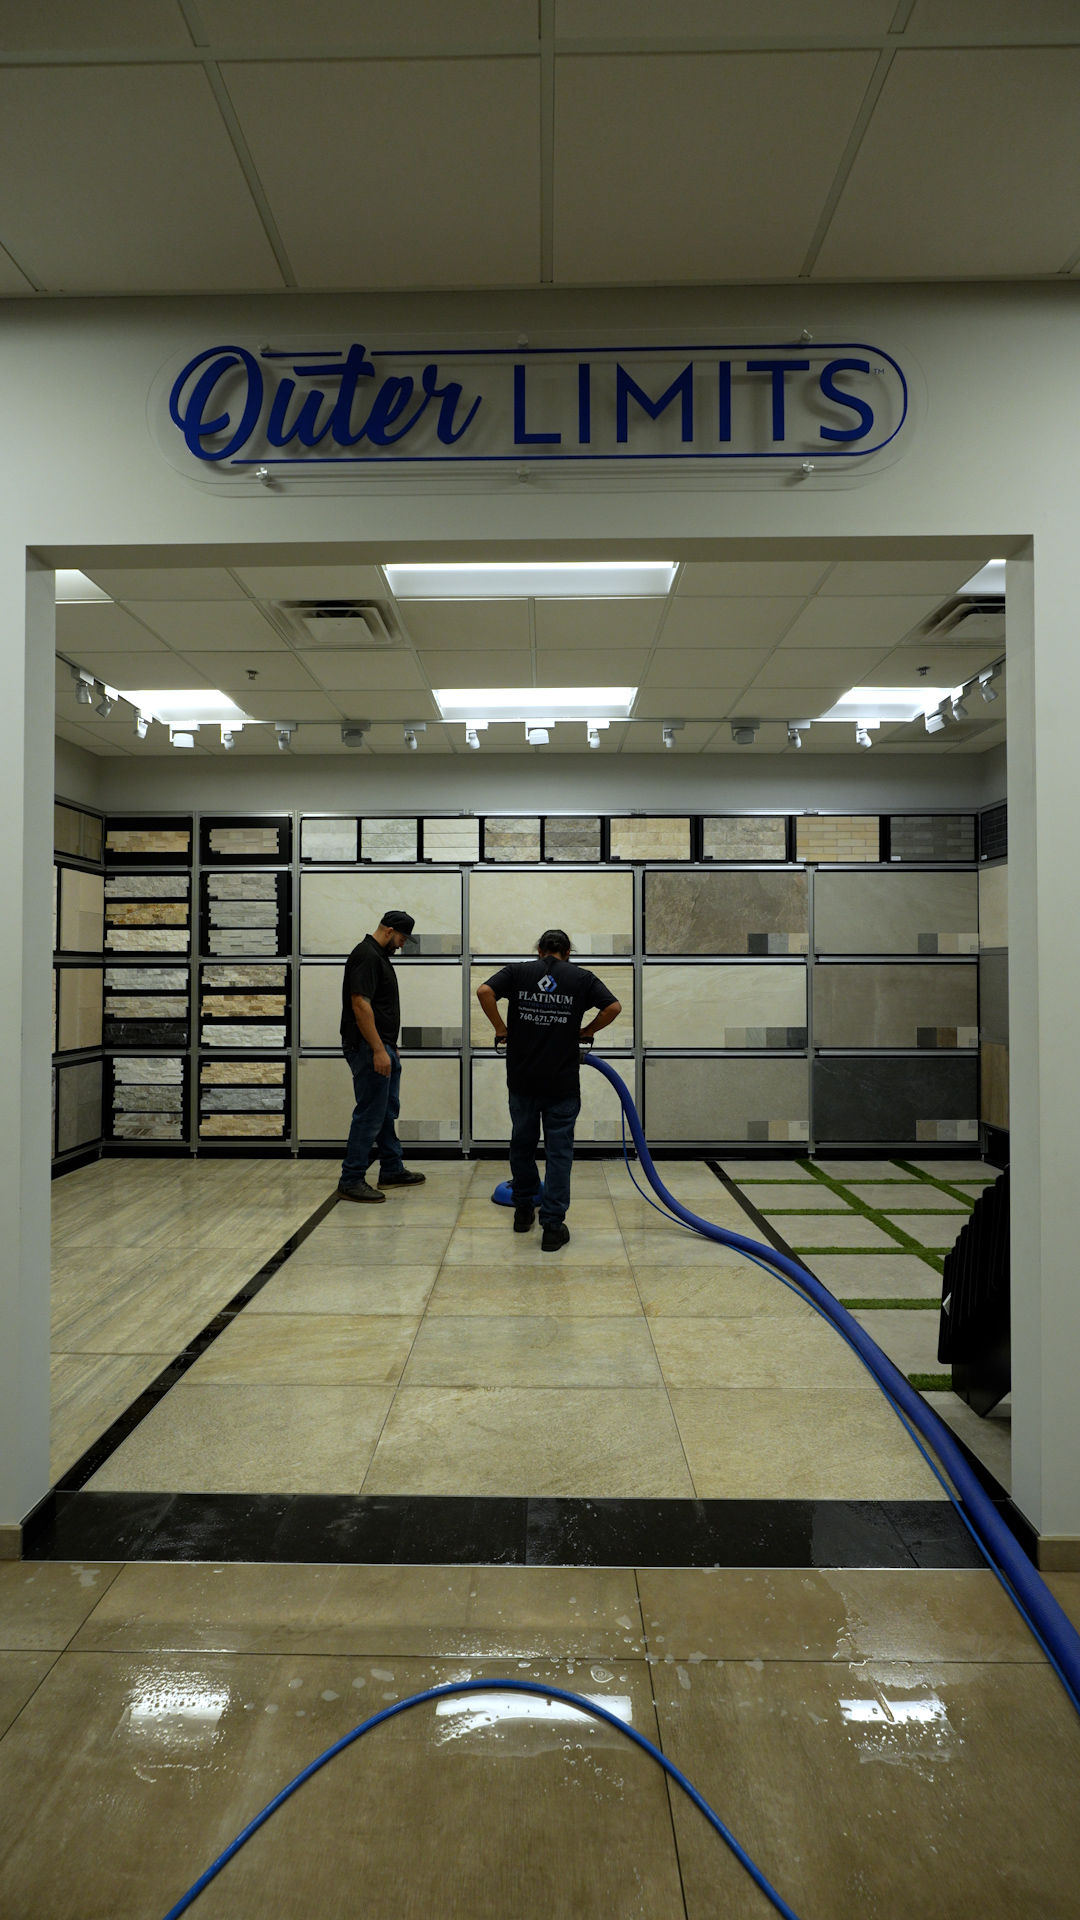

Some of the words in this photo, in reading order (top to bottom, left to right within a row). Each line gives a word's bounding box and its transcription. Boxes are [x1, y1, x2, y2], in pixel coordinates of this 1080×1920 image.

[169, 343, 482, 462] Outer
[513, 358, 875, 445] LIMITS
[518, 991, 573, 1005] PLATINUM
[520, 1012, 568, 1023] 760.671.7948
